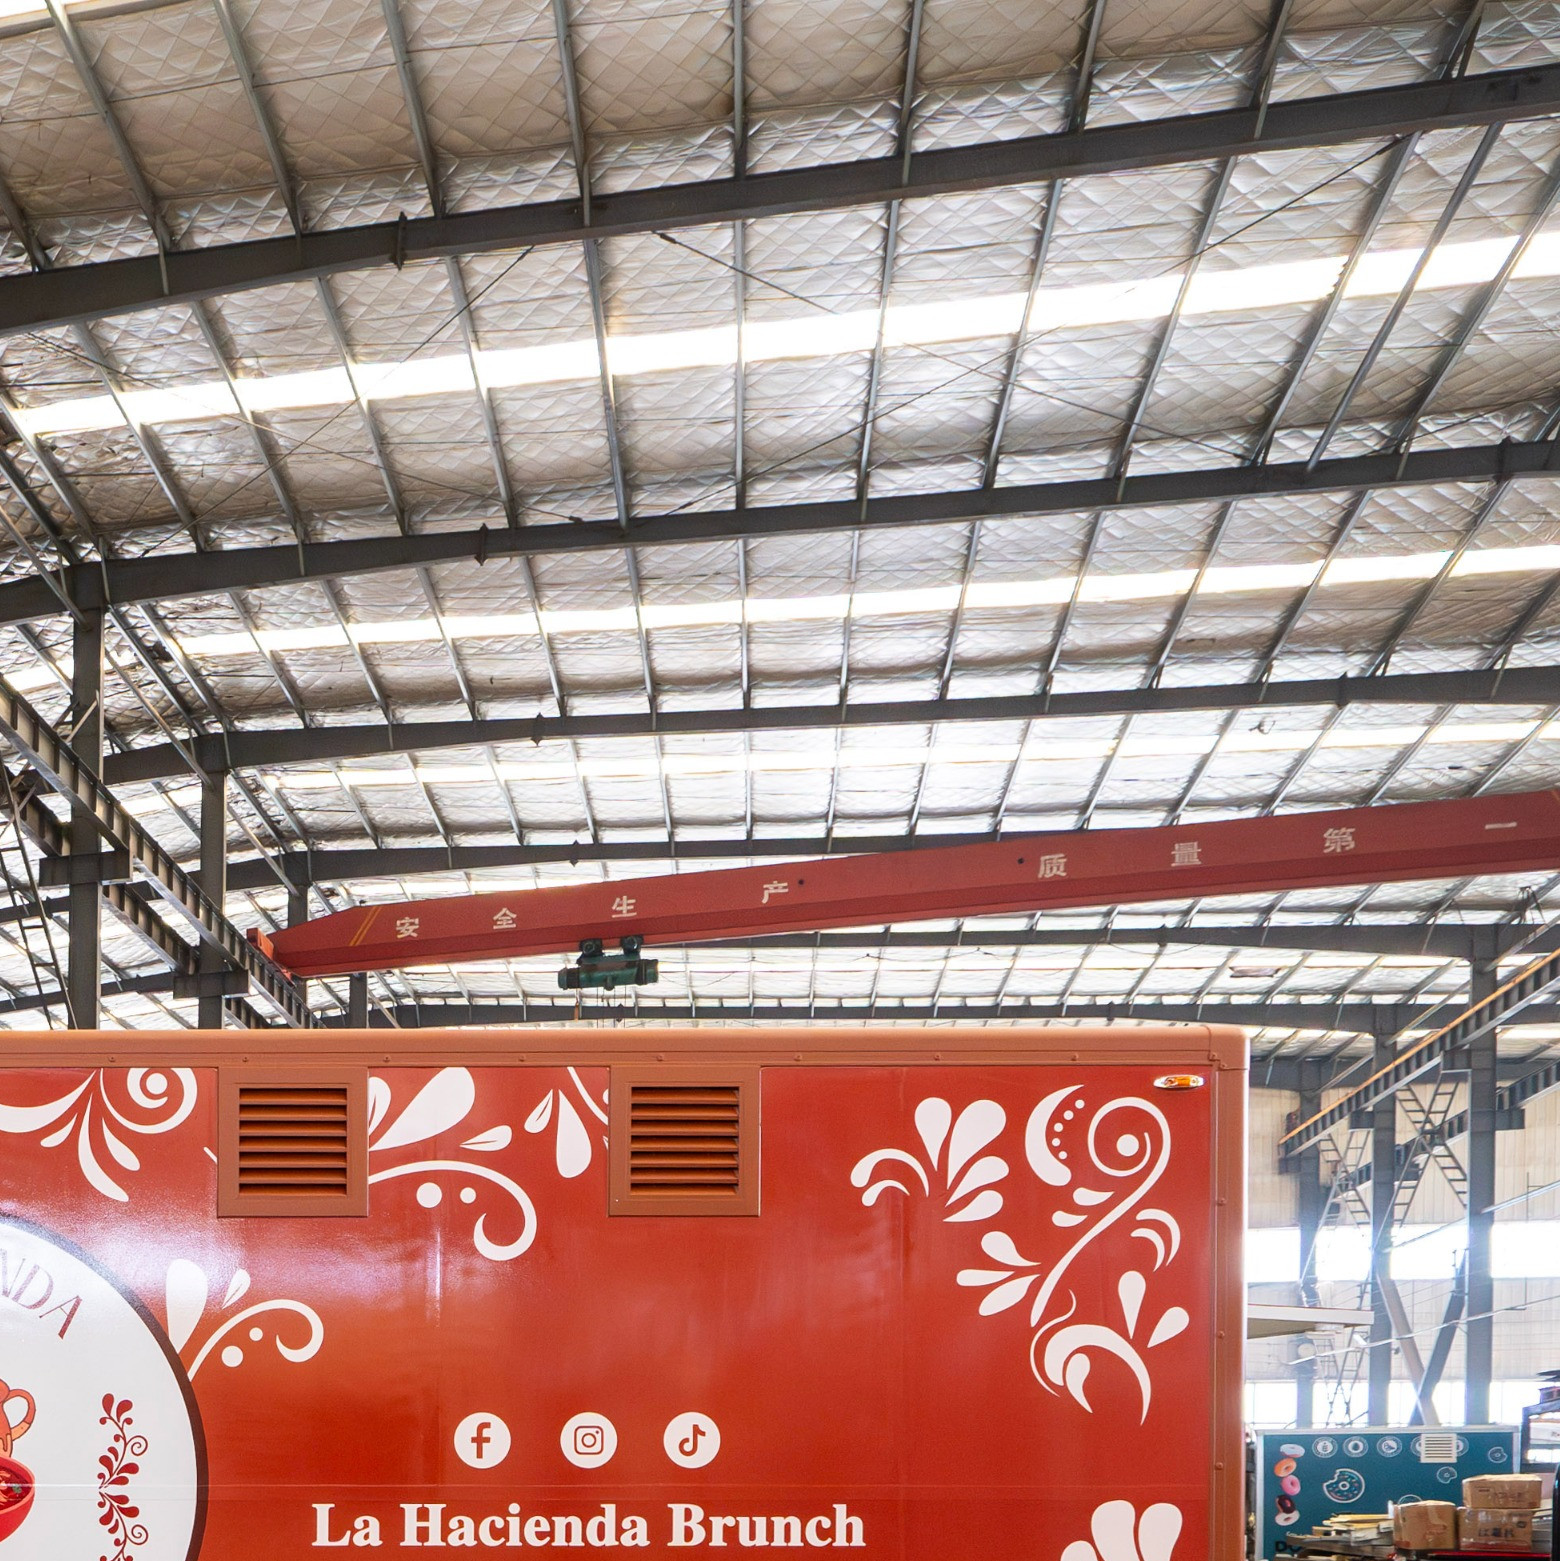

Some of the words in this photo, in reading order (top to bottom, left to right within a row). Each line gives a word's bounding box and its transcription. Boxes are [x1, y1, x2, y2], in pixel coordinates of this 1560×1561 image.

[311, 1503, 382, 1547] La
[399, 1503, 650, 1547] Hacienda
[667, 1503, 866, 1547] Brunch
